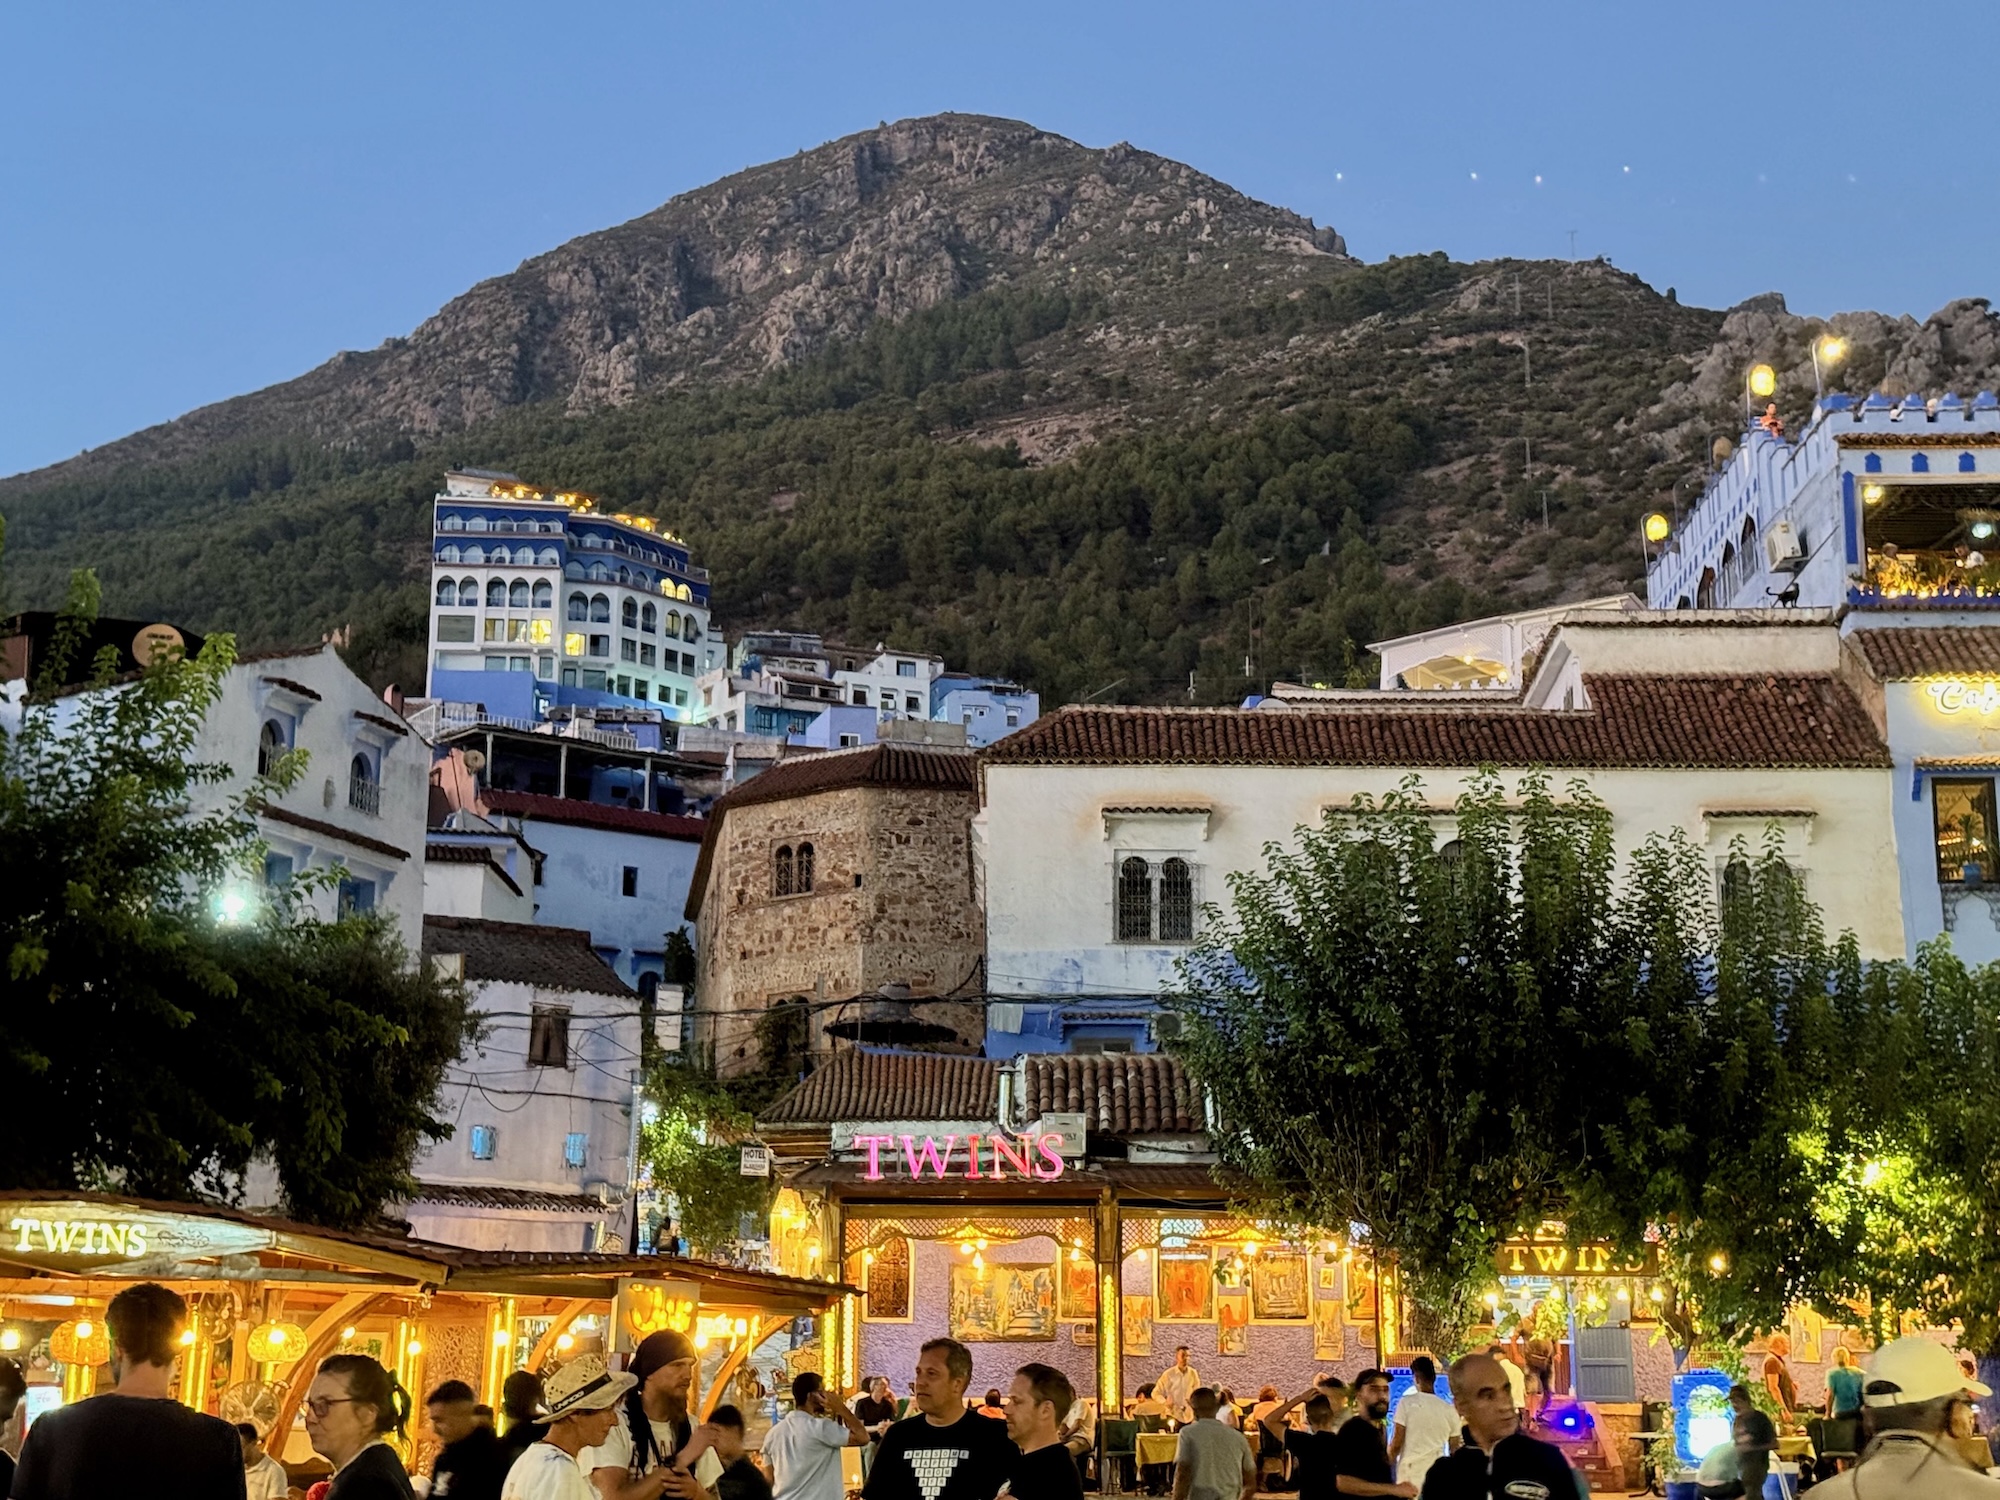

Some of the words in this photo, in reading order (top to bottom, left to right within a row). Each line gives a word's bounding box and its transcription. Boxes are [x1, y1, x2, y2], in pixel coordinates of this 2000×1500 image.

[744, 1149, 766, 1159] HOTEL
[853, 1133, 1065, 1180] TWINS
[10, 1218, 147, 1257] TWINS
[905, 1450, 966, 1458] AWESOME
[916, 1468, 951, 1476] FROM
[920, 1478, 945, 1486] AFR
